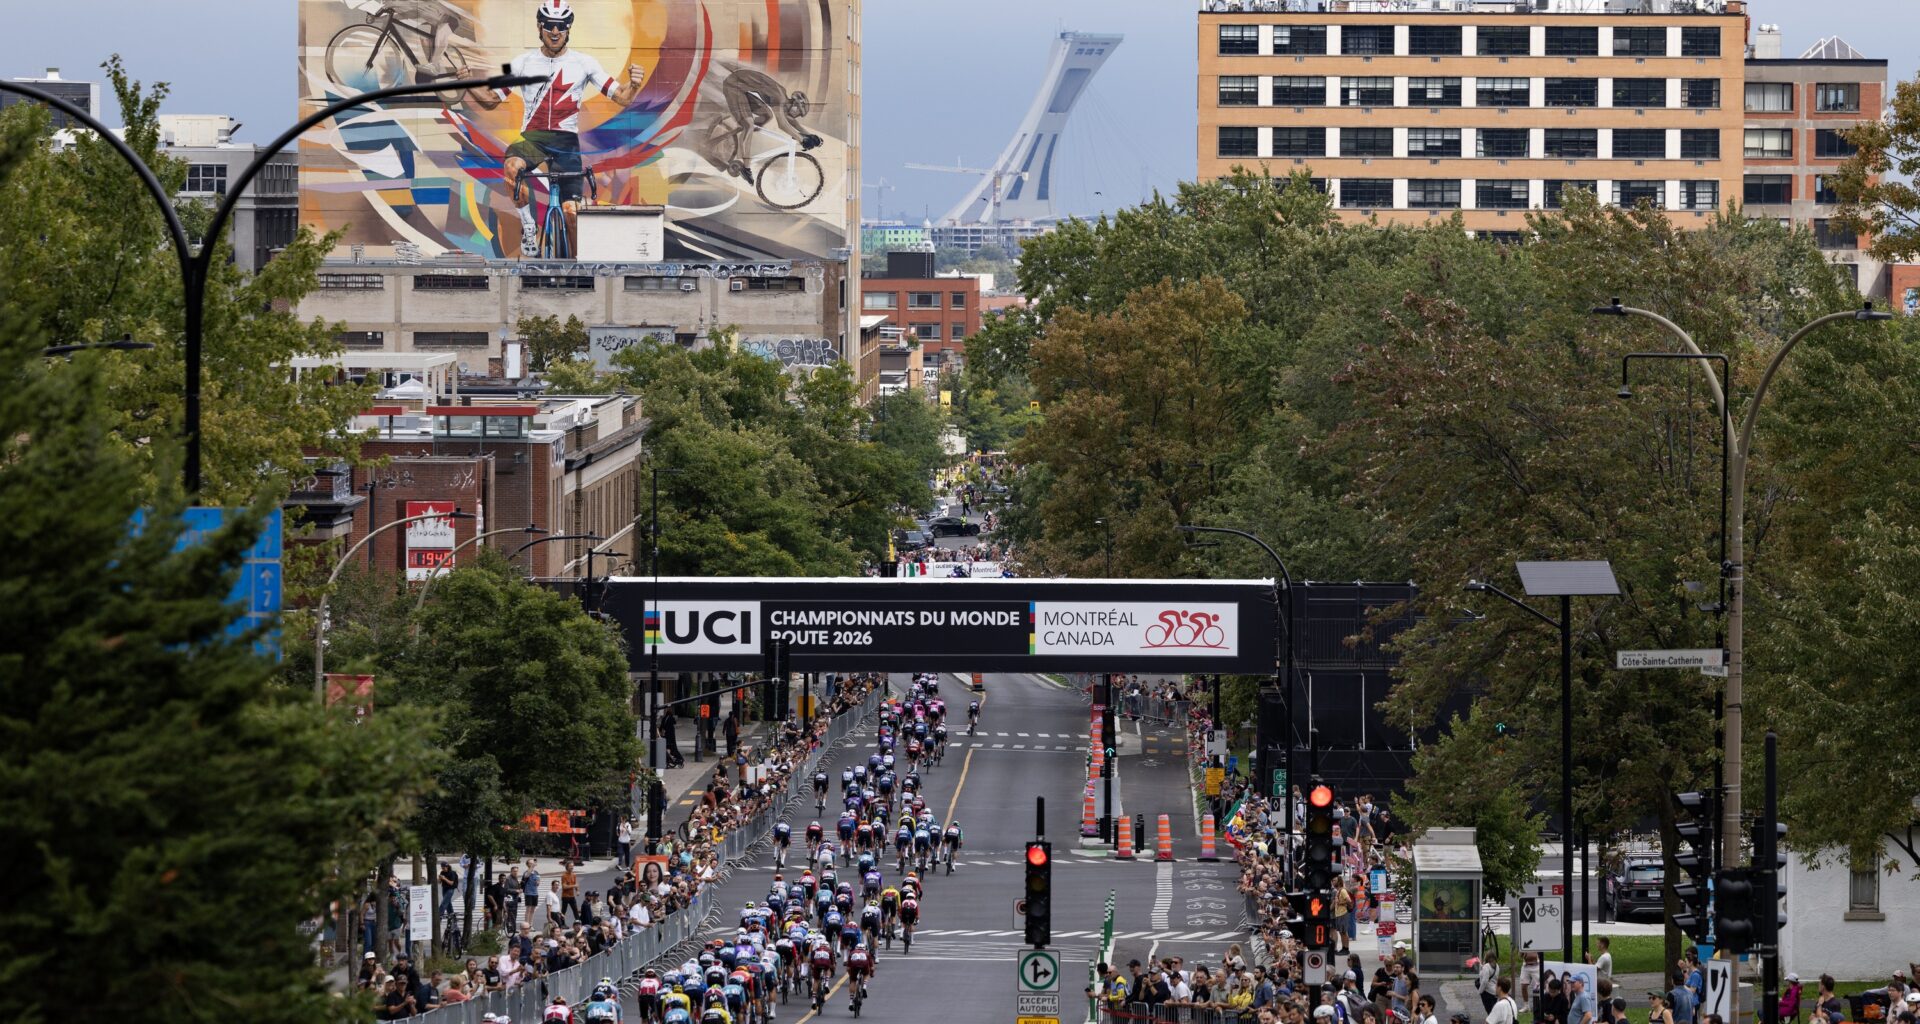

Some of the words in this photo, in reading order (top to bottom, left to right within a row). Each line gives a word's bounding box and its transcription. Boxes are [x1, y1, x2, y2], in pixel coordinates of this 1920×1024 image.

[770, 611, 915, 626] CHAMPIONNATS
[920, 611, 945, 626] DU
[950, 611, 1020, 626] MONDE
[1044, 608, 1138, 626] MONTRÉAL
[665, 610, 752, 645] UCI
[771, 630, 828, 645] ROUTE
[833, 631, 873, 645] 2026
[1043, 631, 1115, 646] CANADA
[1621, 656, 1704, 666] Côte-Sainte-Catherine
[1020, 995, 1057, 1004] EXCEPTÉ
